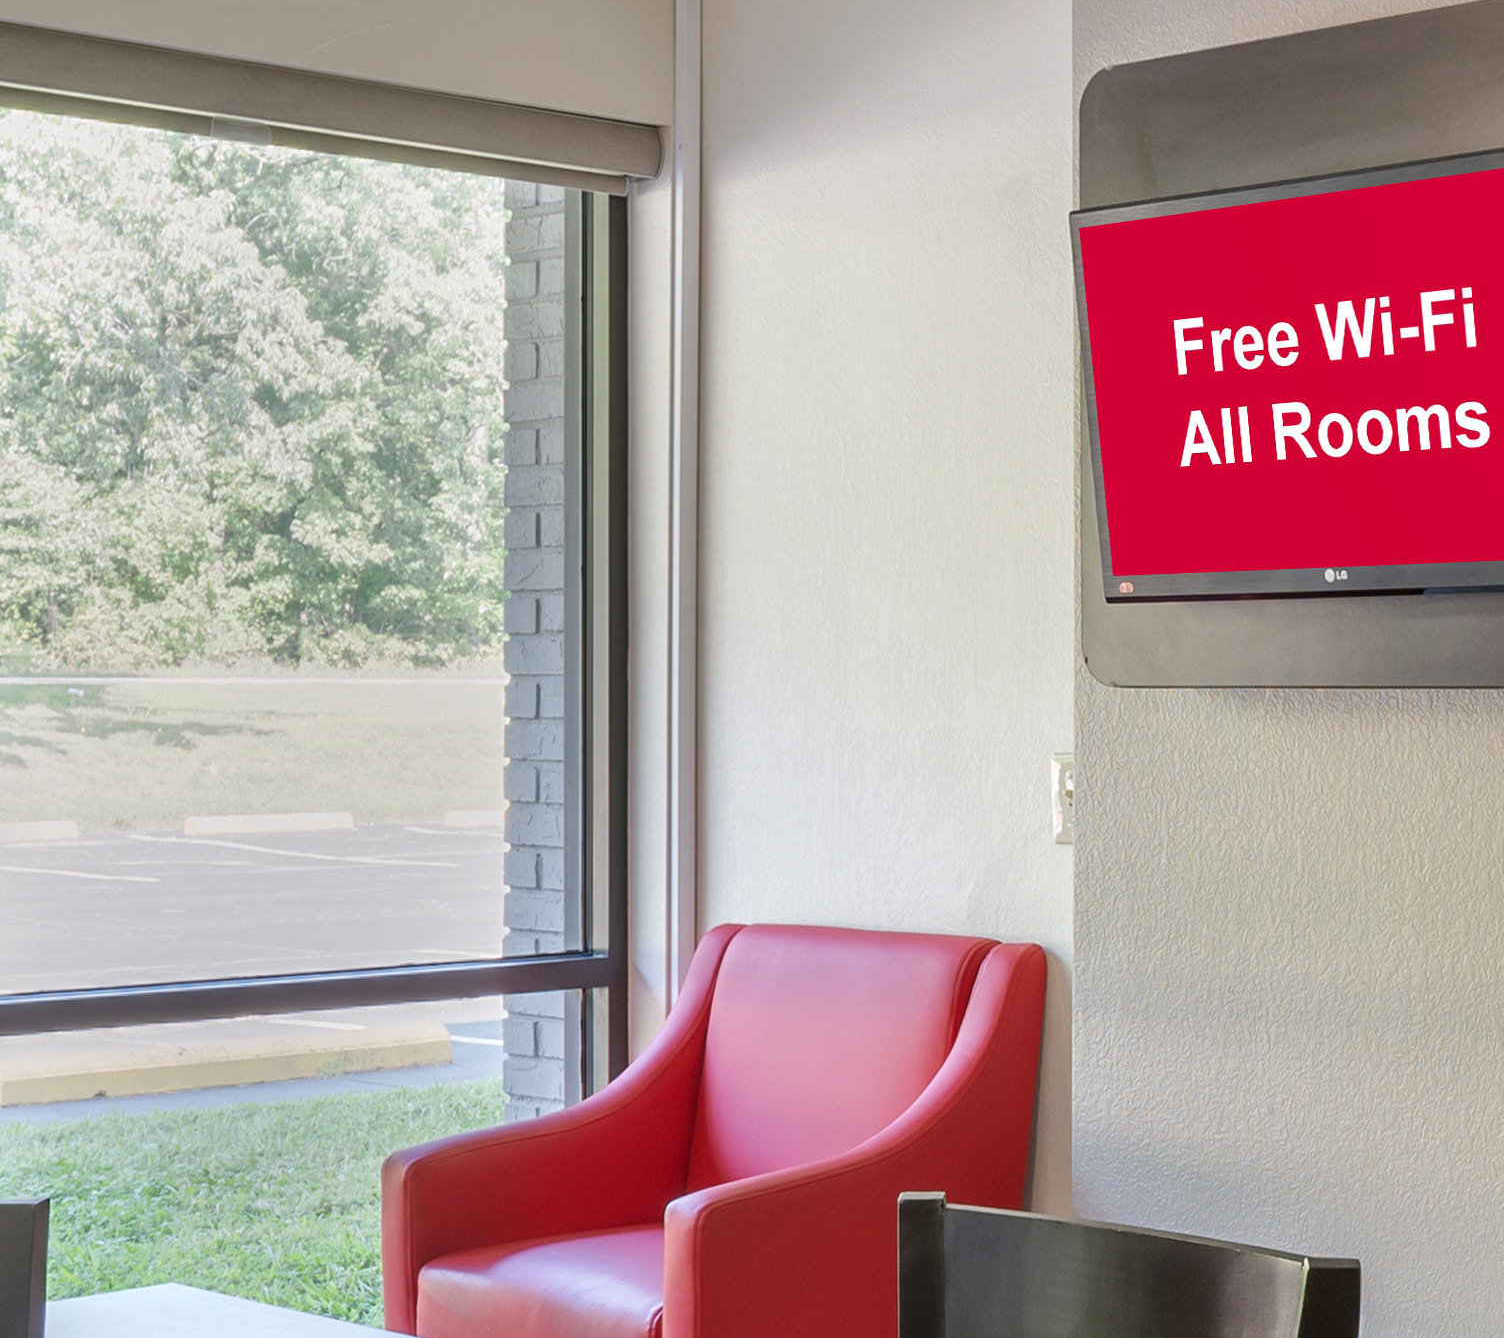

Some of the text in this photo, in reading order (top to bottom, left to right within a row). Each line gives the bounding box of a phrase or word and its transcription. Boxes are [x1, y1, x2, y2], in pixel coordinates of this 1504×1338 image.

[1173, 287, 1478, 375] Free Wi-Fi
[1180, 401, 1491, 467] All Rooms
[1336, 570, 1348, 580] LG
